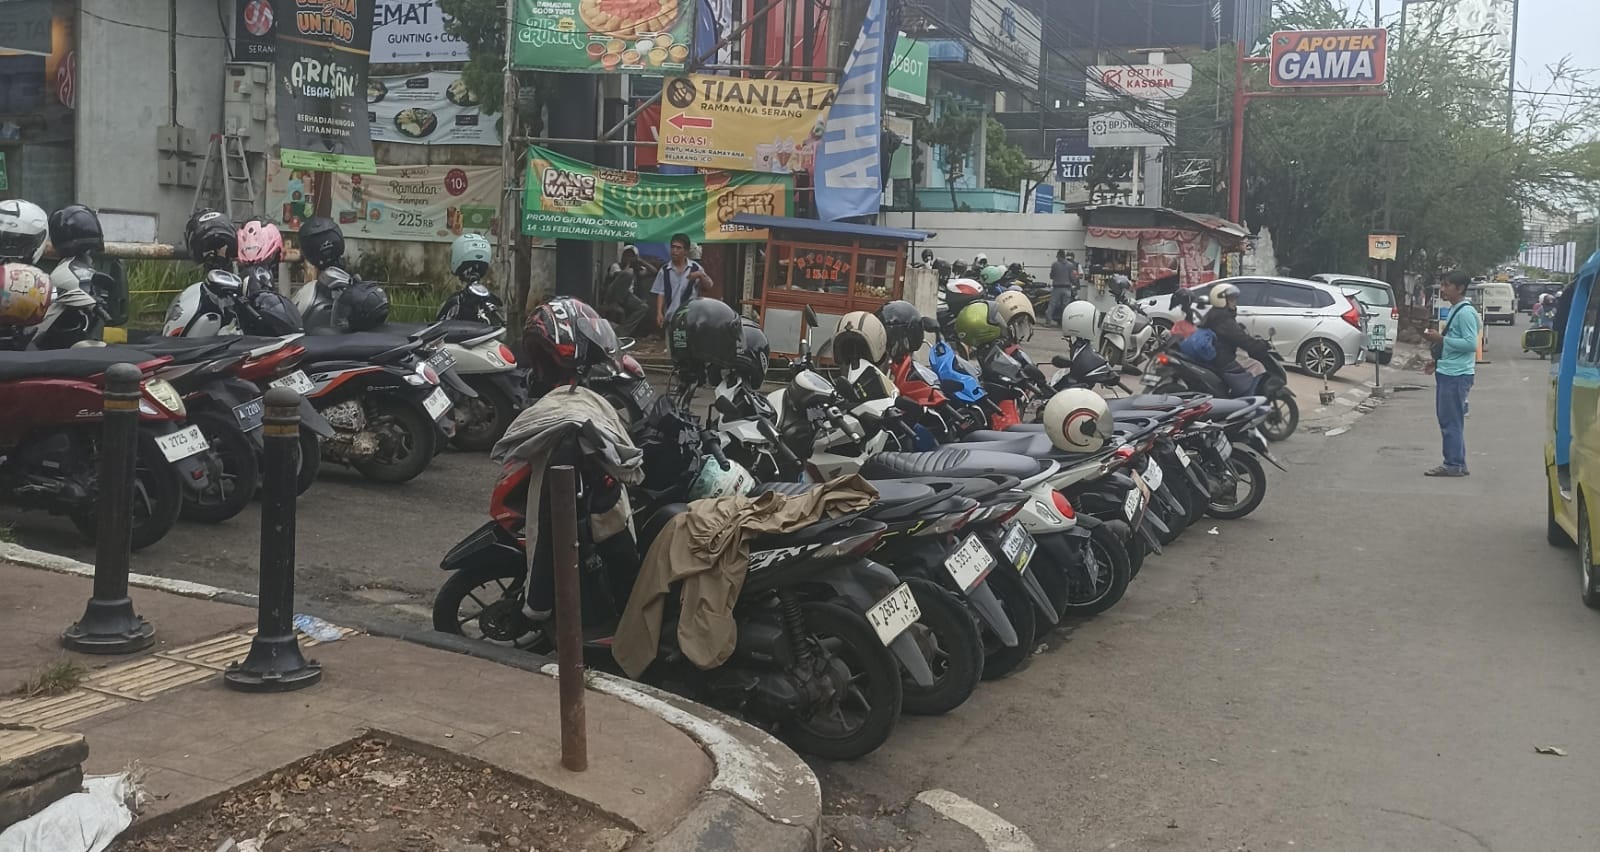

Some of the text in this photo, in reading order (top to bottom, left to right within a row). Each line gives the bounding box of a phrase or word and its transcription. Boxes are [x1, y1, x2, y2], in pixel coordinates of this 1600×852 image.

[388, 33, 432, 43] GUNTING
[1295, 35, 1376, 52] APOTEK
[248, 45, 276, 53] SERAN
[1279, 50, 1372, 80] GAMA
[701, 79, 837, 111] TIANLALA
[701, 102, 802, 118] RAMAYANA SERANG
[666, 135, 707, 146] LOKASI
[544, 168, 594, 188] PANG
[389, 180, 437, 195] Ramadan
[545, 184, 594, 200] WAFFLE
[624, 201, 686, 219] SOON
[398, 213, 422, 227] 225
[526, 213, 638, 228] PROMO GRAND OPENING
[949, 562, 957, 574] A
[871, 613, 881, 627] A
[878, 596, 901, 620] 2692
